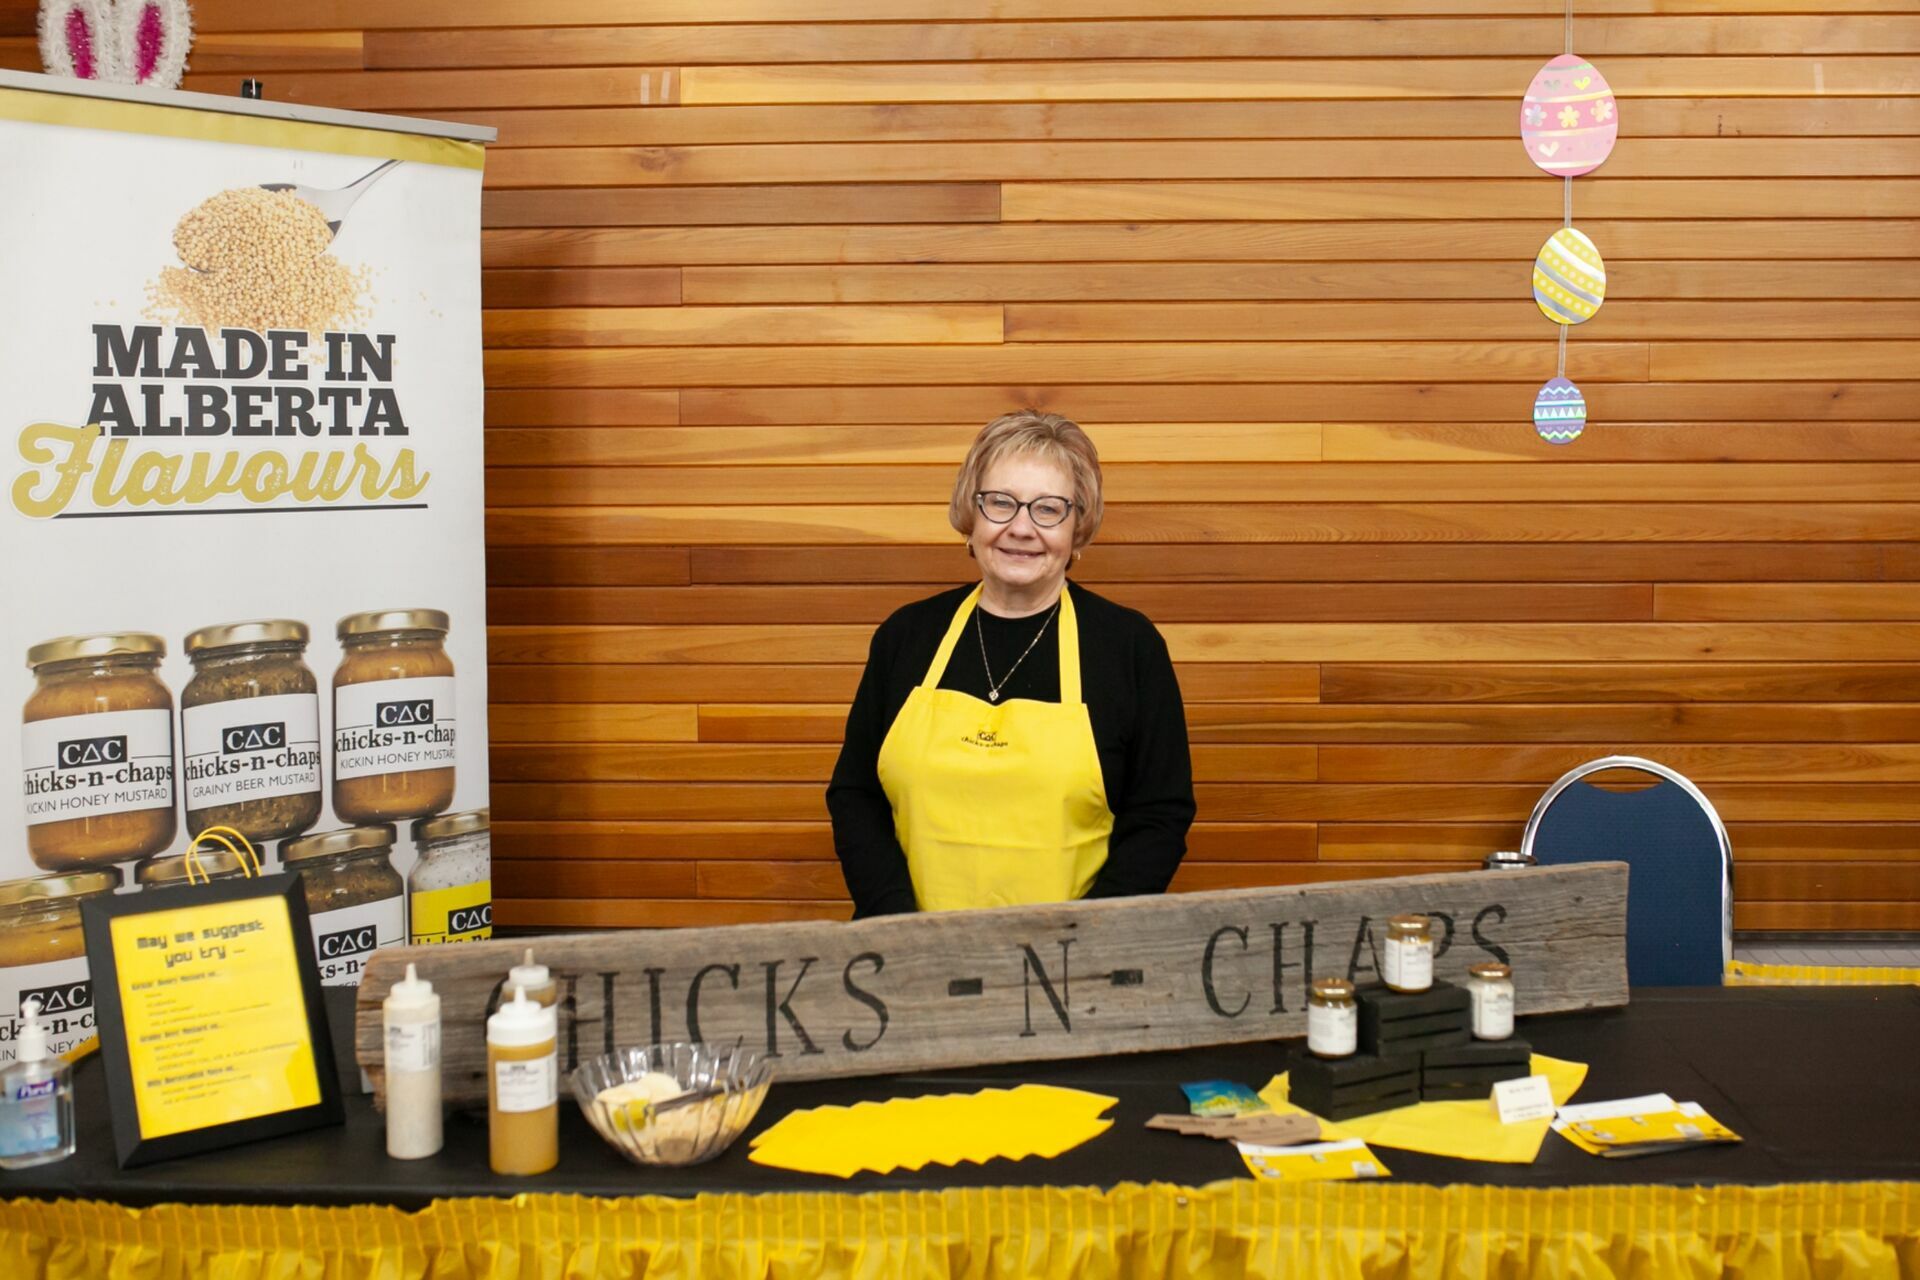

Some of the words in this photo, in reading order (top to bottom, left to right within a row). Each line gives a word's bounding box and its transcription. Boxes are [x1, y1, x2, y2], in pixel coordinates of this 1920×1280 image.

[92, 324, 308, 380] MADE
[324, 332, 396, 382] IN
[81, 384, 409, 436] ALBERTA
[11, 421, 431, 519] Flavours
[340, 756, 374, 769] KICKIN
[377, 751, 421, 765] HONEY
[24, 762, 172, 796] hicks-n-chaps
[193, 782, 232, 798] GRAINY
[236, 777, 265, 792] BEER
[269, 772, 316, 787] MUSTARD
[60, 792, 111, 811] HONEY
[114, 787, 168, 804] MUSTARD
[174, 931, 195, 944] we
[202, 919, 264, 941] suggest
[164, 950, 193, 968] you
[200, 945, 227, 961] try
[1017, 938, 1078, 1037] N
